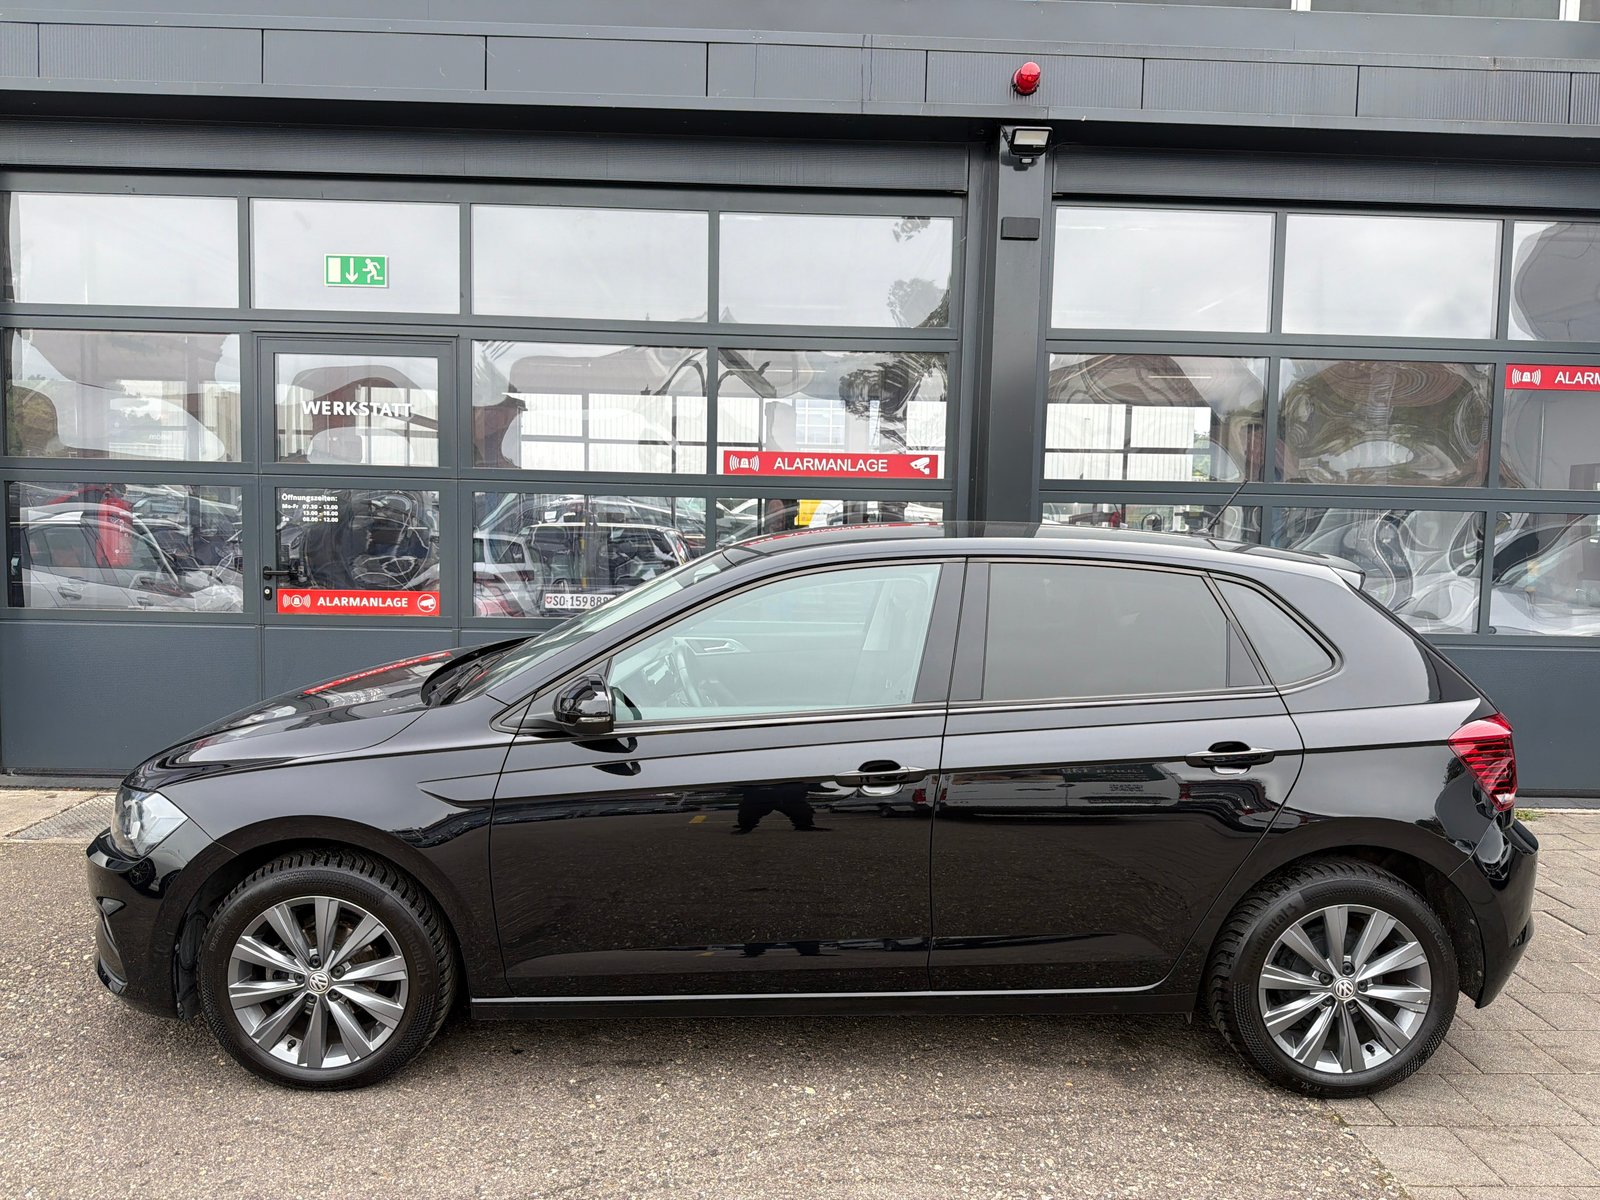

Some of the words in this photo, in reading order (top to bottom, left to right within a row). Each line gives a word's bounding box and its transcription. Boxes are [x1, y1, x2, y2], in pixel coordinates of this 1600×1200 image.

[302, 400, 412, 418] WERKSTATT
[773, 457, 888, 472] ALARMANLAGE
[282, 493, 338, 502] Öffnungszeiten:
[317, 596, 408, 607] ALARMANLAGE
